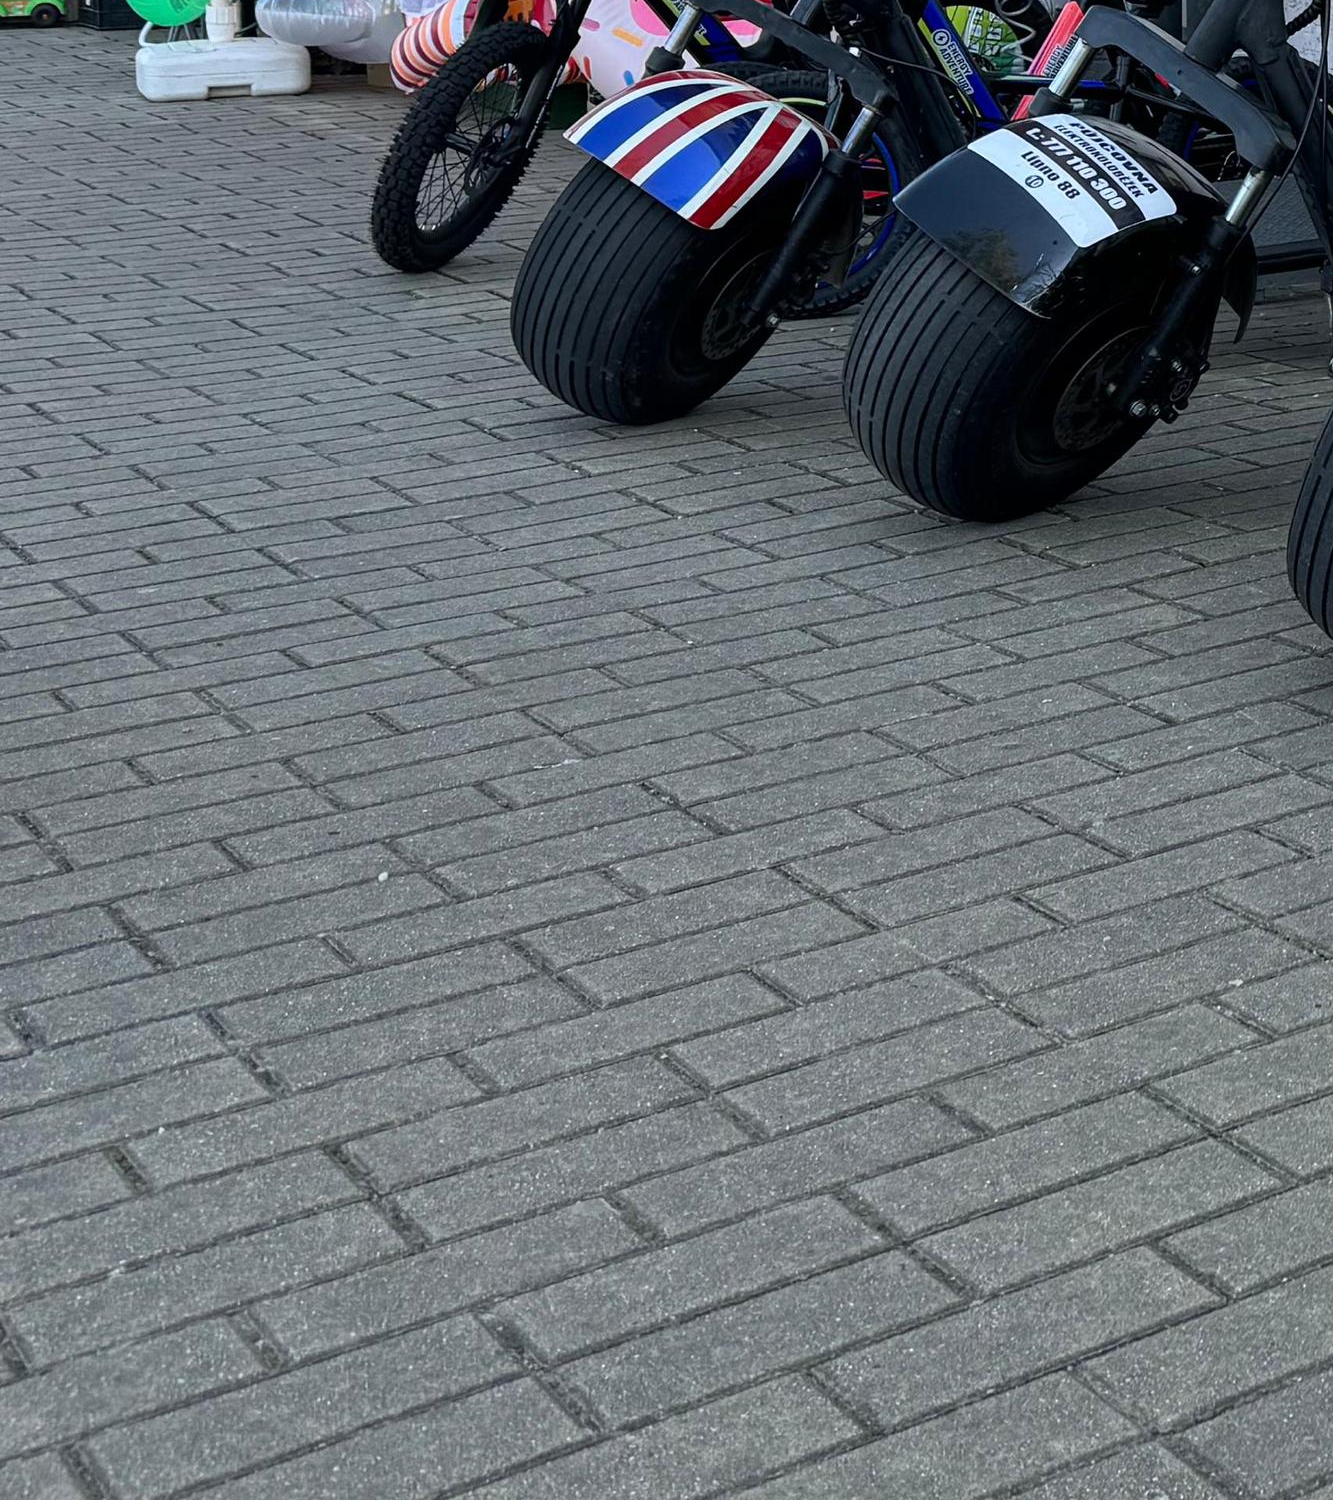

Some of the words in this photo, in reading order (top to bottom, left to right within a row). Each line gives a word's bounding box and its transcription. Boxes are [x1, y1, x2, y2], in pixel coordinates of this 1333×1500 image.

[940, 47, 974, 96] ADVENTURE
[949, 40, 973, 76] ENERGY
[1021, 151, 1060, 181] Lipno
[1057, 181, 1081, 200] 88
[1041, 137, 1074, 156] 777
[1066, 155, 1098, 180] 110
[1090, 178, 1127, 209] 300
